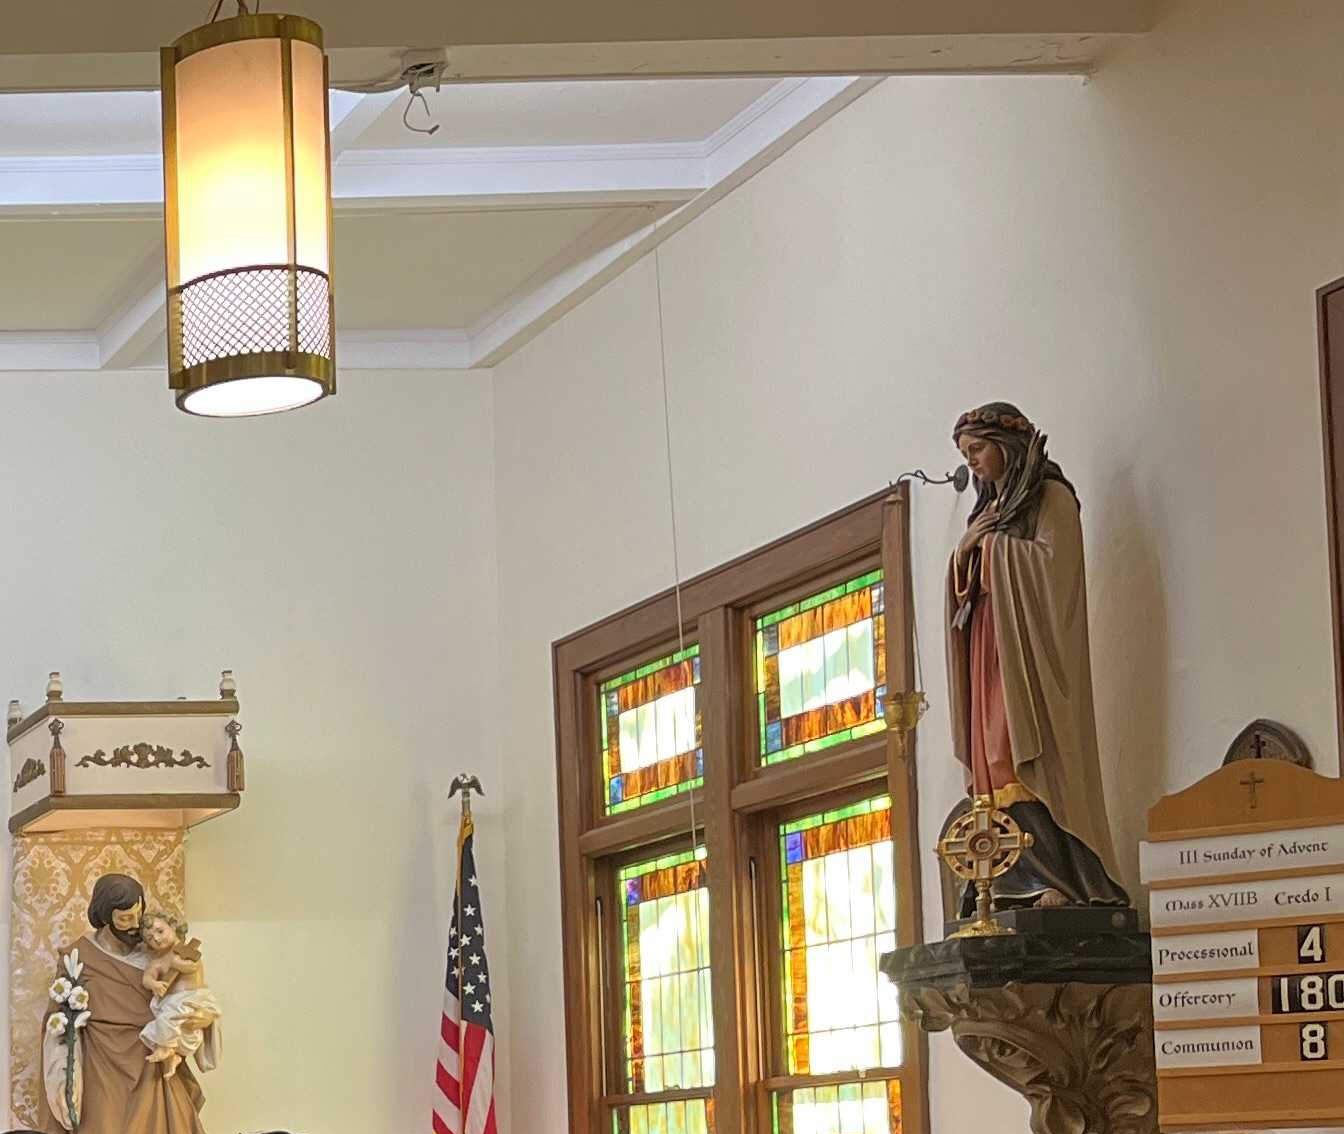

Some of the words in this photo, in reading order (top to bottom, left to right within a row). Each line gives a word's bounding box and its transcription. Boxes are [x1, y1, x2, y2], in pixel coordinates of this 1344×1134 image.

[1179, 850, 1198, 865] III
[1203, 848, 1255, 864] Sunday
[1259, 843, 1274, 858] of
[1278, 840, 1329, 856] Advent
[1165, 899, 1204, 912] Mass
[1208, 891, 1258, 908] XVIIB
[1274, 888, 1320, 906] Credo
[1324, 887, 1332, 902] I
[1158, 942, 1254, 965] Processional
[1299, 926, 1323, 961] 4
[1159, 991, 1236, 1008] Offertory
[1280, 973, 1344, 1012] 180
[1161, 1039, 1254, 1055] Communion
[1302, 1023, 1325, 1059] 8
